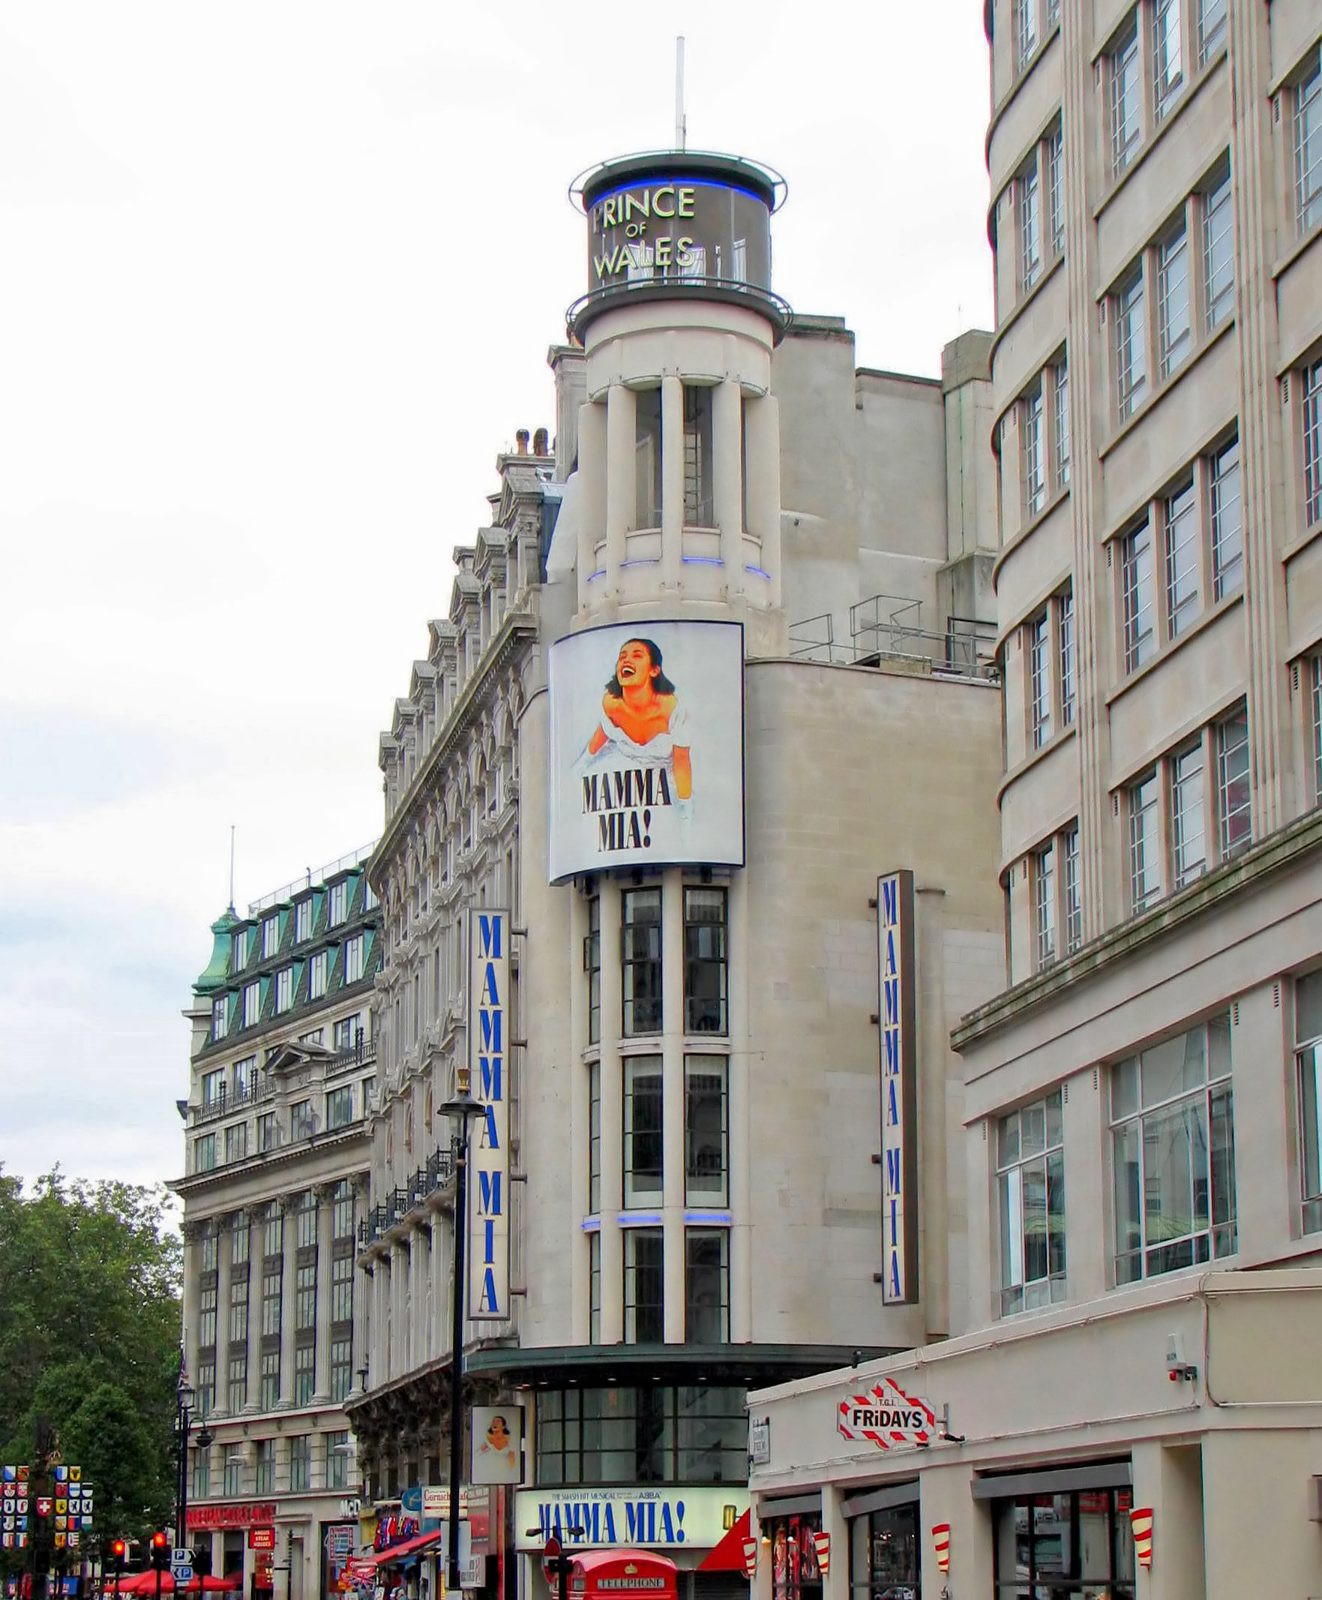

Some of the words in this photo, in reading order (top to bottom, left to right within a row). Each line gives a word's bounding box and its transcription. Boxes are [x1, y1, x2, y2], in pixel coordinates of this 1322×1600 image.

[593, 187, 695, 234] PRINCE
[625, 221, 647, 238] OF
[593, 236, 695, 280] WALES
[582, 767, 672, 814] MAMMA
[598, 808, 652, 852] MIA!
[882, 879, 899, 1126] MAMMA
[478, 915, 503, 1149] MAMMA
[477, 1171, 503, 1313] MIA
[886, 1148, 901, 1298] MIA
[538, 1502, 618, 1544] MAMMA
[624, 1500, 685, 1543] MIA!
[599, 1578, 663, 1588] TELEPHONE
